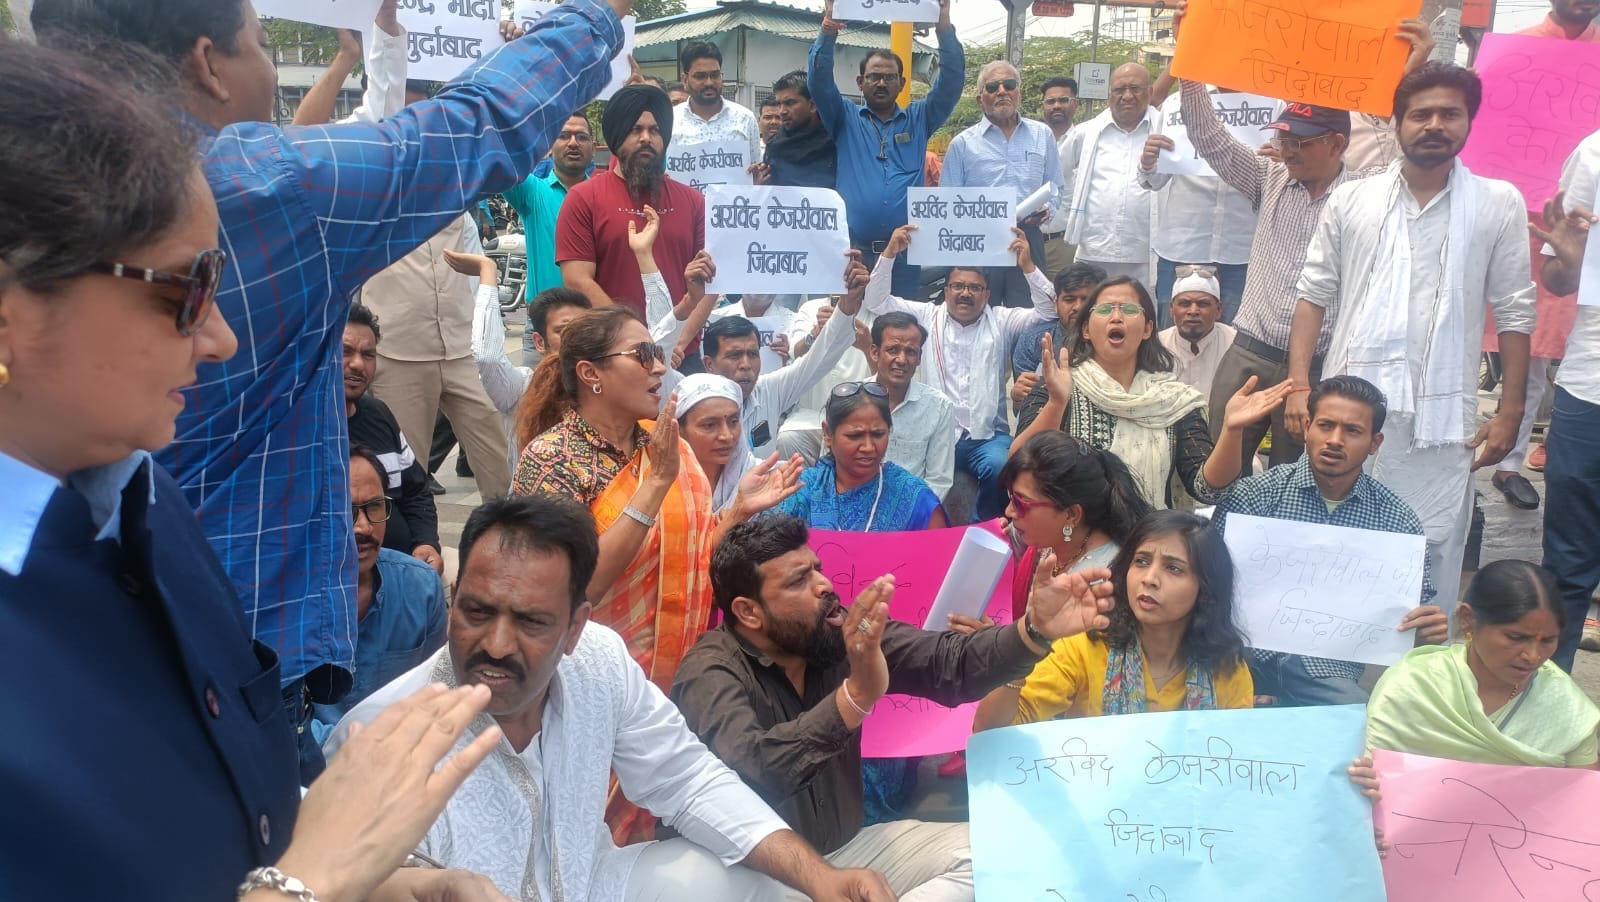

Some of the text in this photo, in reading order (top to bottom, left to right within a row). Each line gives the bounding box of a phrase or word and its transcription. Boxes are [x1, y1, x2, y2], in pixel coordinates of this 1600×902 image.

[1285, 102, 1313, 118] FILA
[667, 147, 743, 172] अरविंद केजरीवाल
[711, 195, 839, 231] अरविंद केजरीवाल
[911, 195, 1008, 220] अरविंद केजरीवाल
[938, 228, 985, 253] जिंदाबाद
[746, 241, 808, 276] जिंदाबाद
[1145, 736, 1306, 797] केजरीवाल
